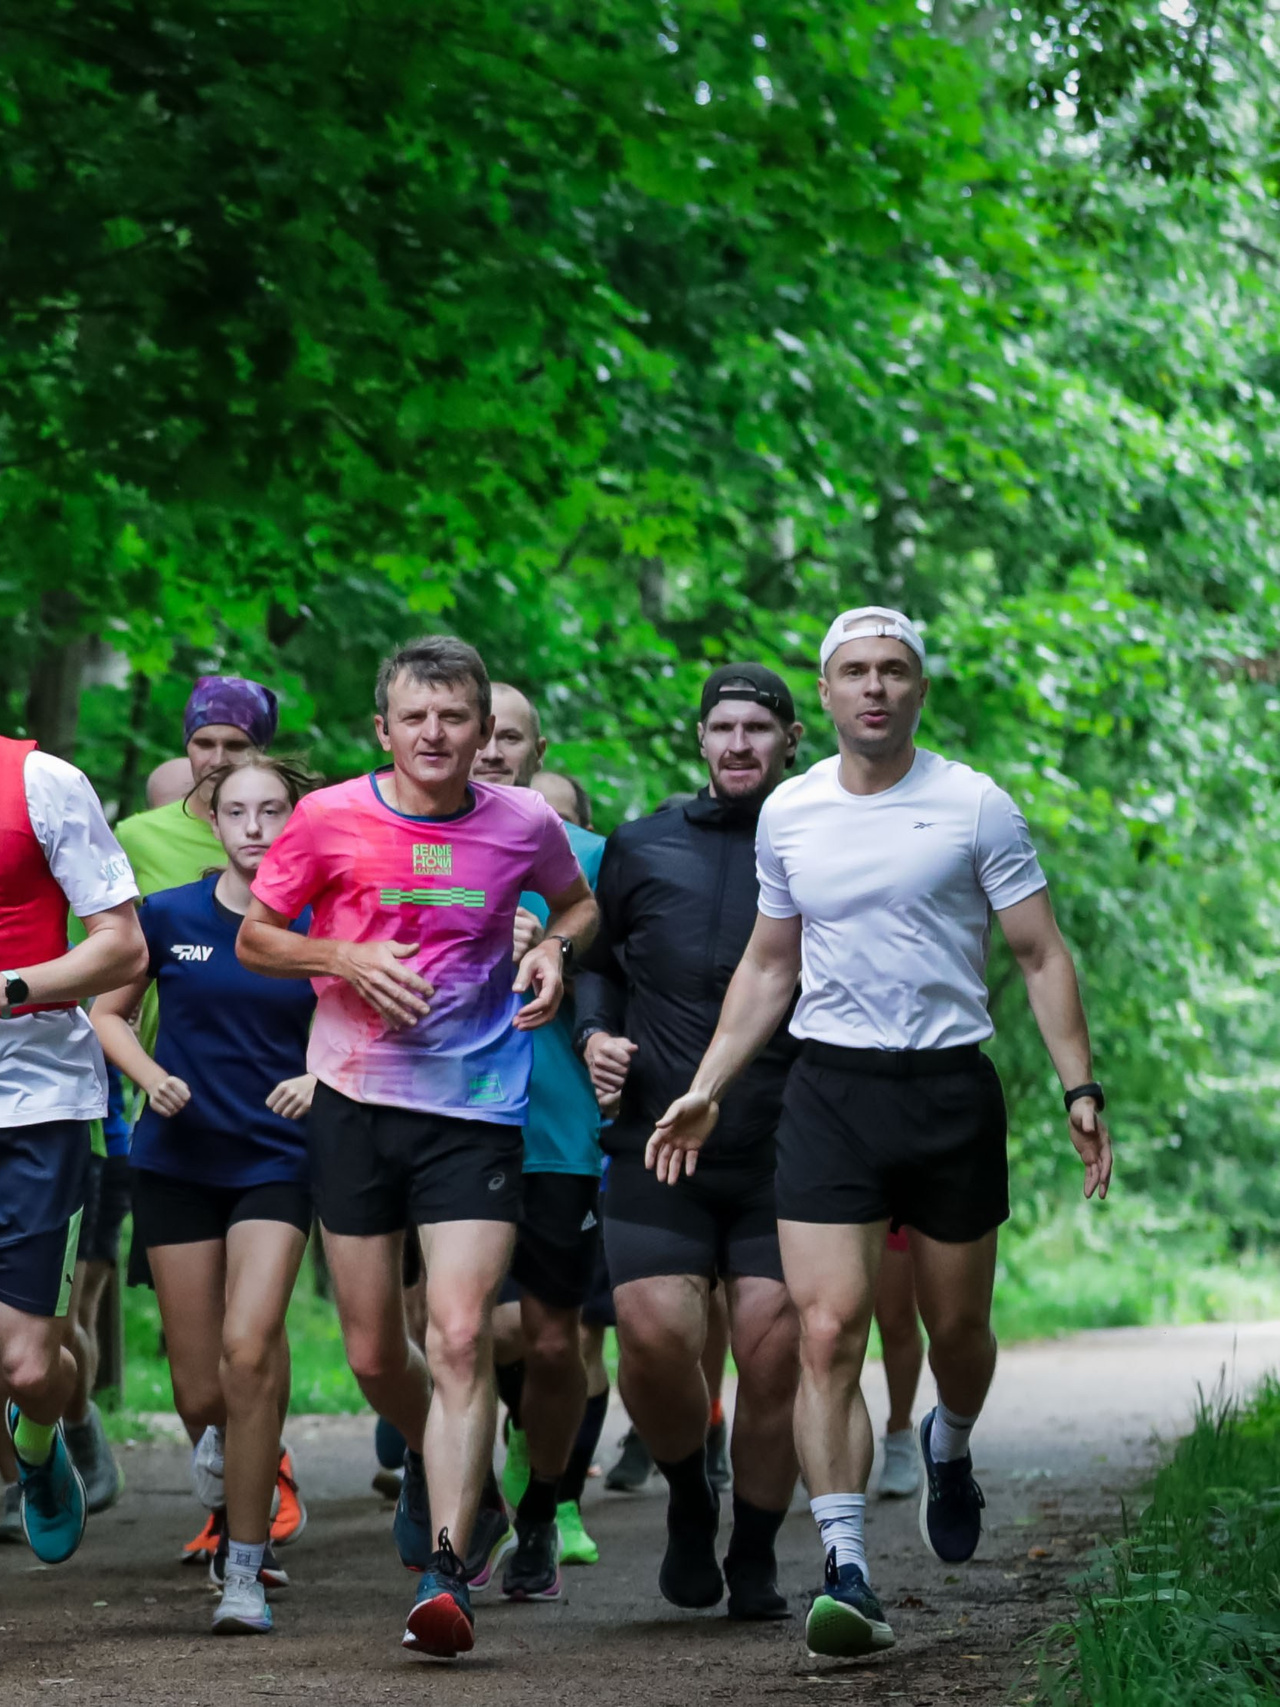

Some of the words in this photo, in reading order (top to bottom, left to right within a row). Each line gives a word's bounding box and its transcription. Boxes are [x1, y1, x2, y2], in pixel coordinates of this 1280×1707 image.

[413, 844, 452, 856] БЕЛЫЕ
[413, 856, 452, 868] НОЧИ
[171, 944, 214, 962] RAY
